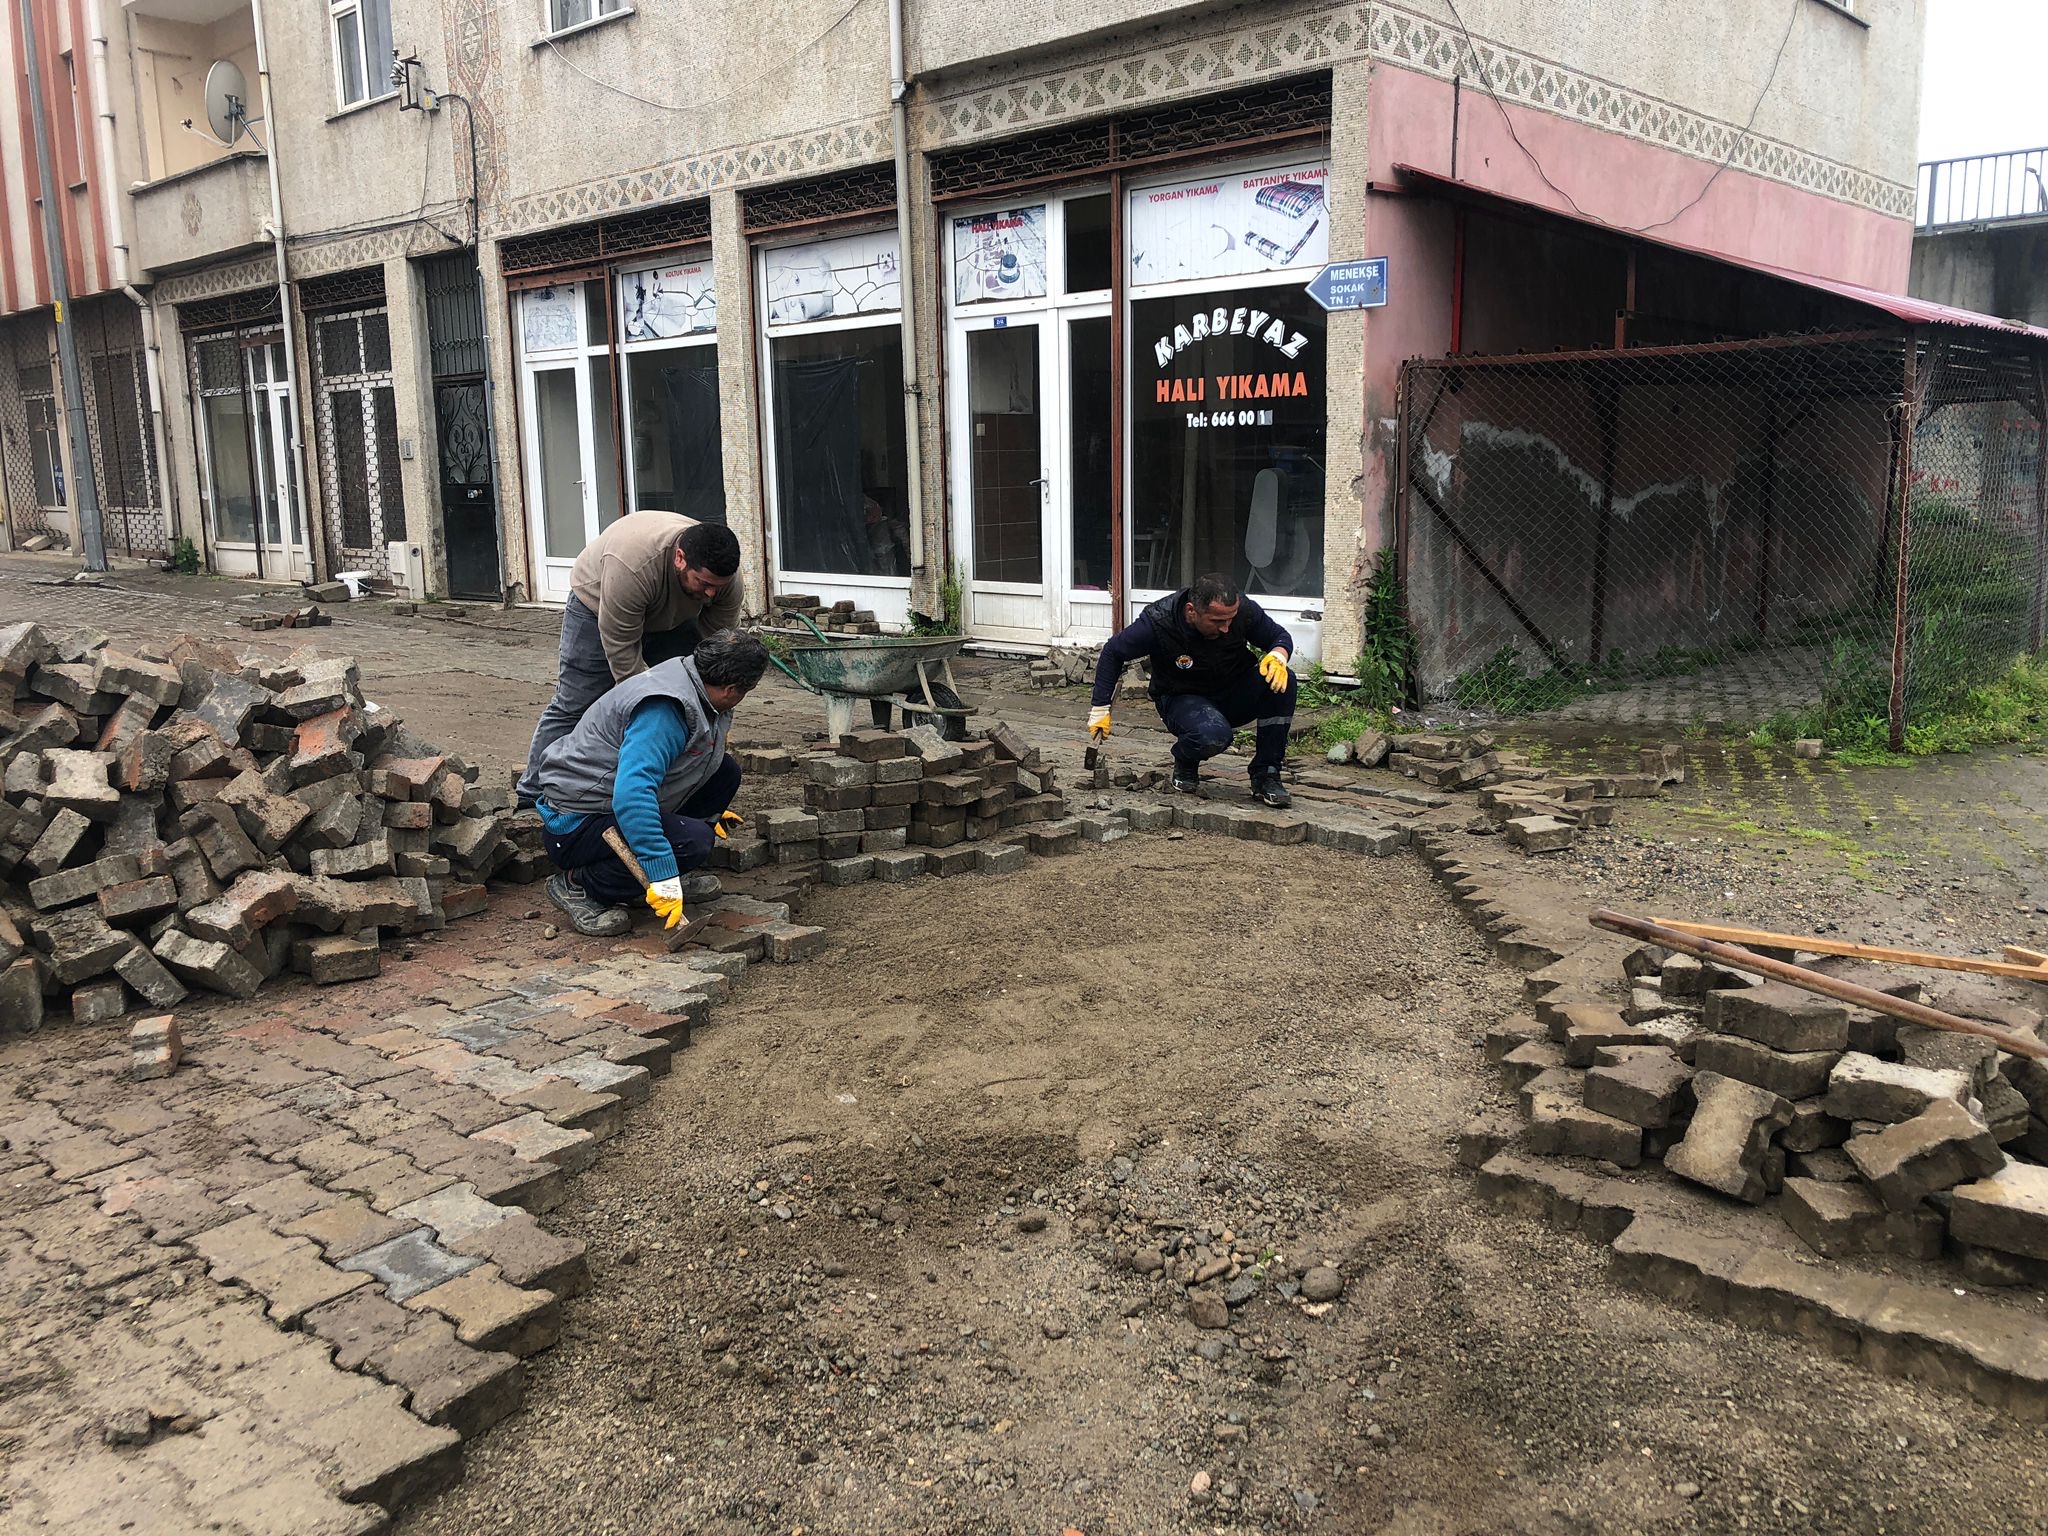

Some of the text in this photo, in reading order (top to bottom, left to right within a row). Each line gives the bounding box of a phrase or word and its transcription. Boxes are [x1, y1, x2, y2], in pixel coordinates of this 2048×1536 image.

[1243, 167, 1329, 189] BATTANİYE YIKAMA
[1148, 184, 1219, 203] YORGAN YIKAMA
[665, 266, 702, 278] KOLTUK YIKAMA
[1330, 265, 1379, 281] MENEKŞE
[1330, 283, 1365, 294] SOKAK
[1155, 307, 1309, 368] KARBEYAZ
[1156, 371, 1308, 403] HALI YIKAMA
[1186, 412, 1208, 428] Tel:
[1211, 410, 1235, 427] 666
[1238, 410, 1255, 426] 00
